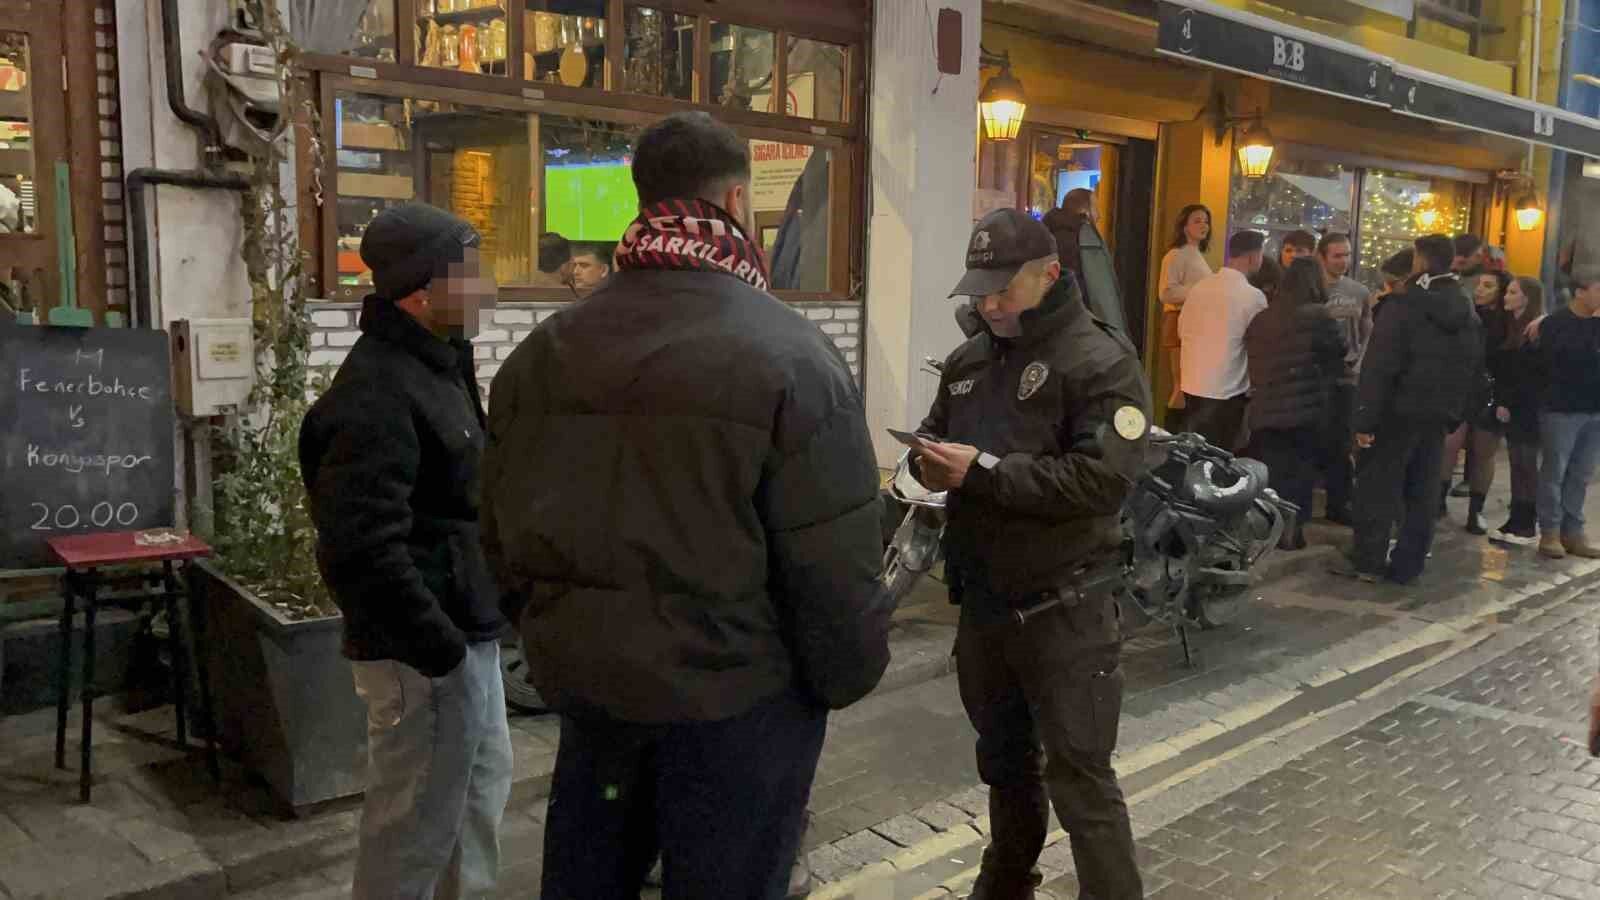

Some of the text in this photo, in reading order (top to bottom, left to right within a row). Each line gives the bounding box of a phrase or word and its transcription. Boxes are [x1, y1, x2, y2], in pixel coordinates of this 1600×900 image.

[1273, 36, 1304, 71] B2B
[27, 443, 152, 475] Konyaspor
[31, 502, 138, 530] 20.00
